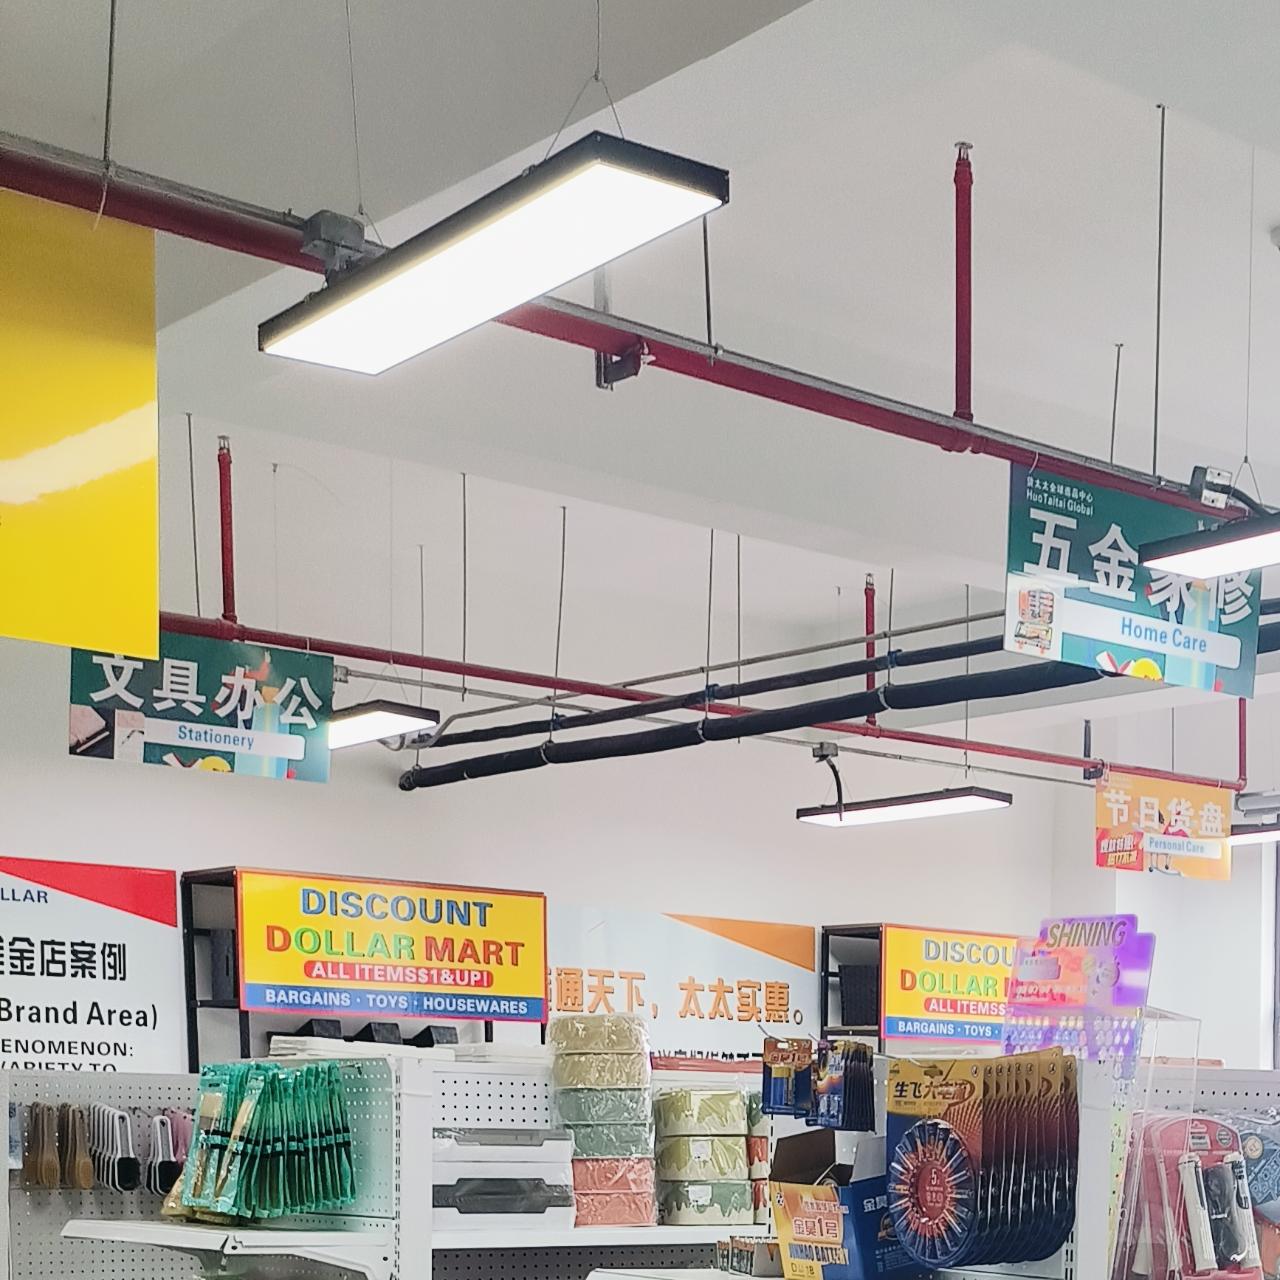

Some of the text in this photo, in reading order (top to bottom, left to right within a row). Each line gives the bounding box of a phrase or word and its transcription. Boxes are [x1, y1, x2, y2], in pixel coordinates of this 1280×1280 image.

[1026, 490, 1094, 516] HuoTaitai Global
[1121, 616, 1207, 653] Home Care
[90, 654, 323, 730] 文具办公
[178, 724, 255, 750] Stationery
[1149, 838, 1185, 852] Personal
[1186, 841, 1205, 854] Care
[302, 887, 493, 927] DISCOUNT
[266, 925, 524, 966] DOLLAR MART
[1046, 921, 1127, 948] SHINING
[0, 936, 126, 981] 金店案例
[312, 962, 351, 979] ALL
[549, 967, 803, 1025] 通天下，太太实惠。
[901, 969, 998, 997] DOLLAR
[265, 988, 528, 1015] BARGAINS TOYS HOUSEWARES
[929, 999, 954, 1012] ALL
[86, 1001, 157, 1031] Area)
[898, 1021, 992, 1037] BARGAINS TOYS
[1, 1038, 134, 1057] ENOMENON:
